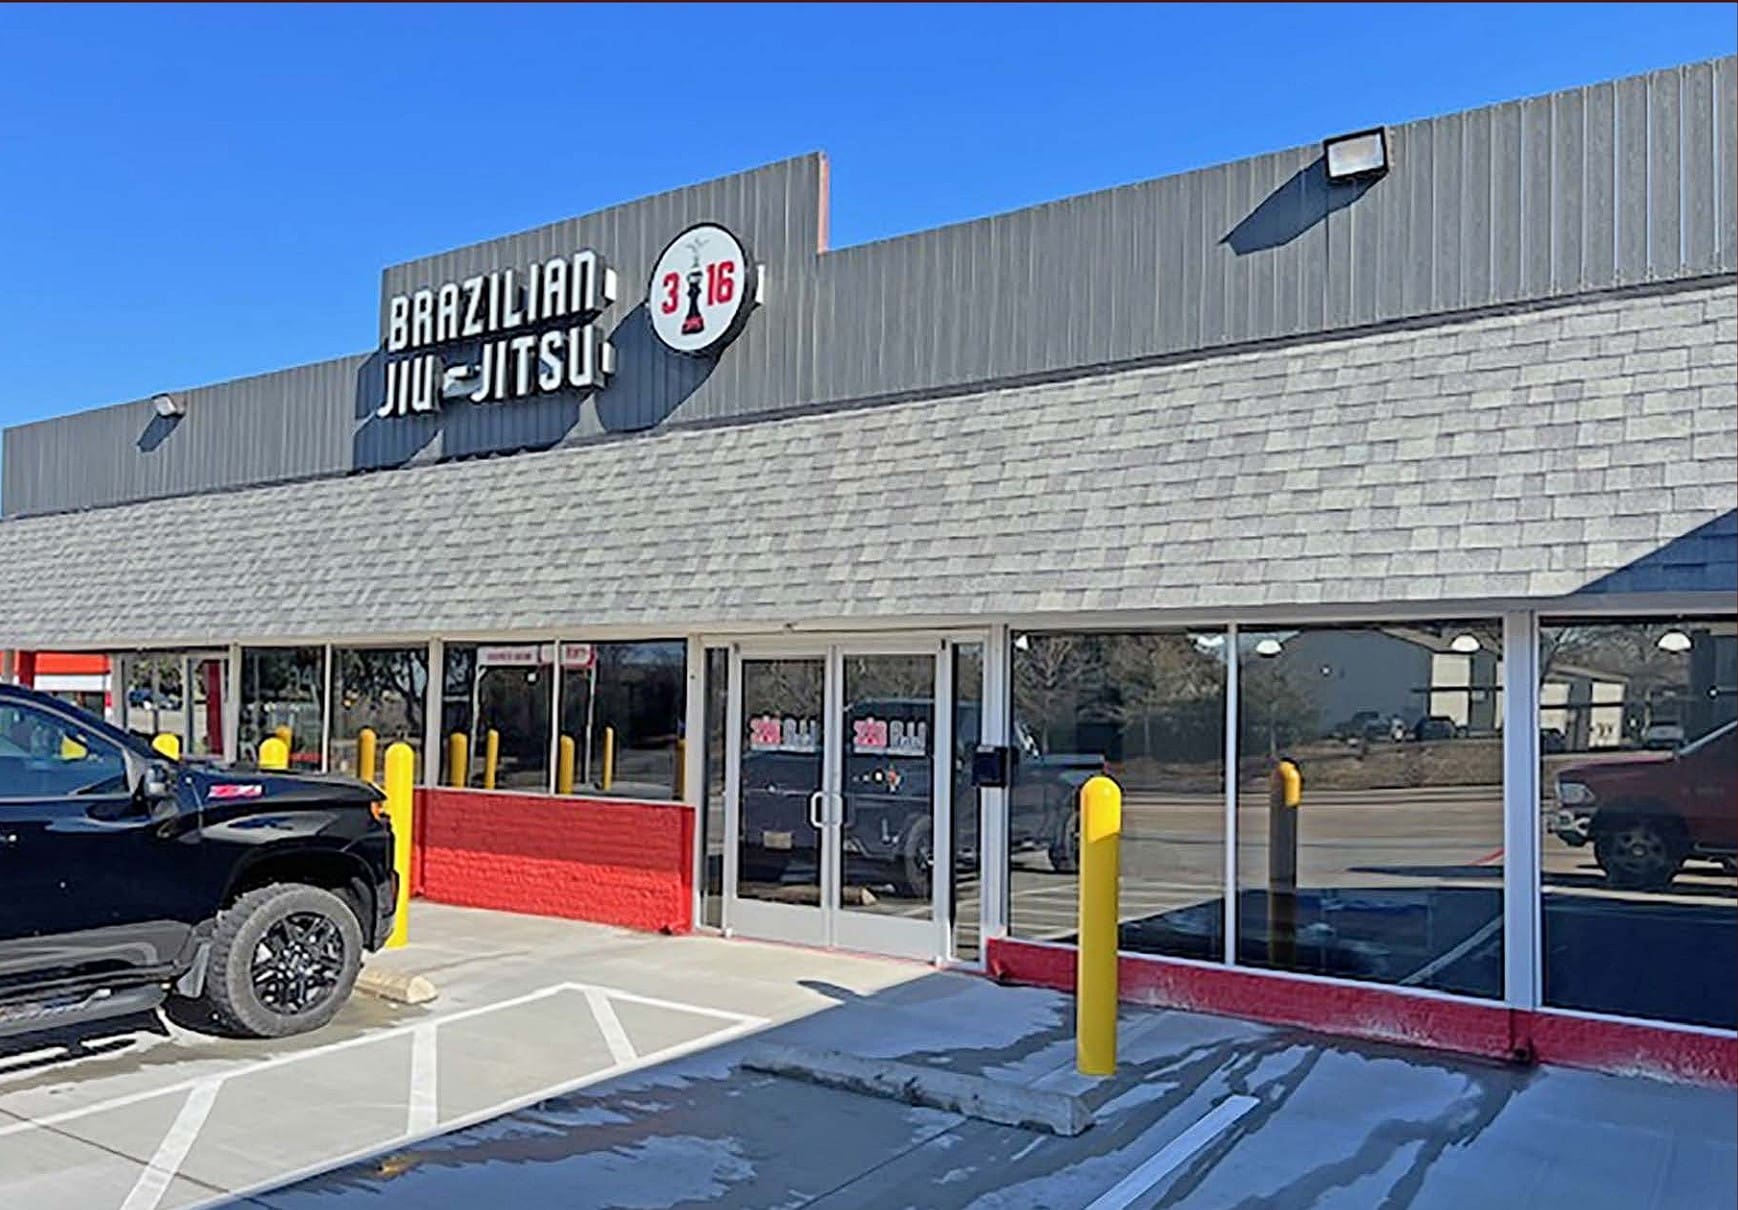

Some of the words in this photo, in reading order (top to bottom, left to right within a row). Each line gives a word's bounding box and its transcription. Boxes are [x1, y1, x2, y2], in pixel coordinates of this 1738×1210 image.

[388, 248, 597, 352] BRAZILIAN
[661, 271, 680, 315] 3
[706, 260, 736, 307] 16
